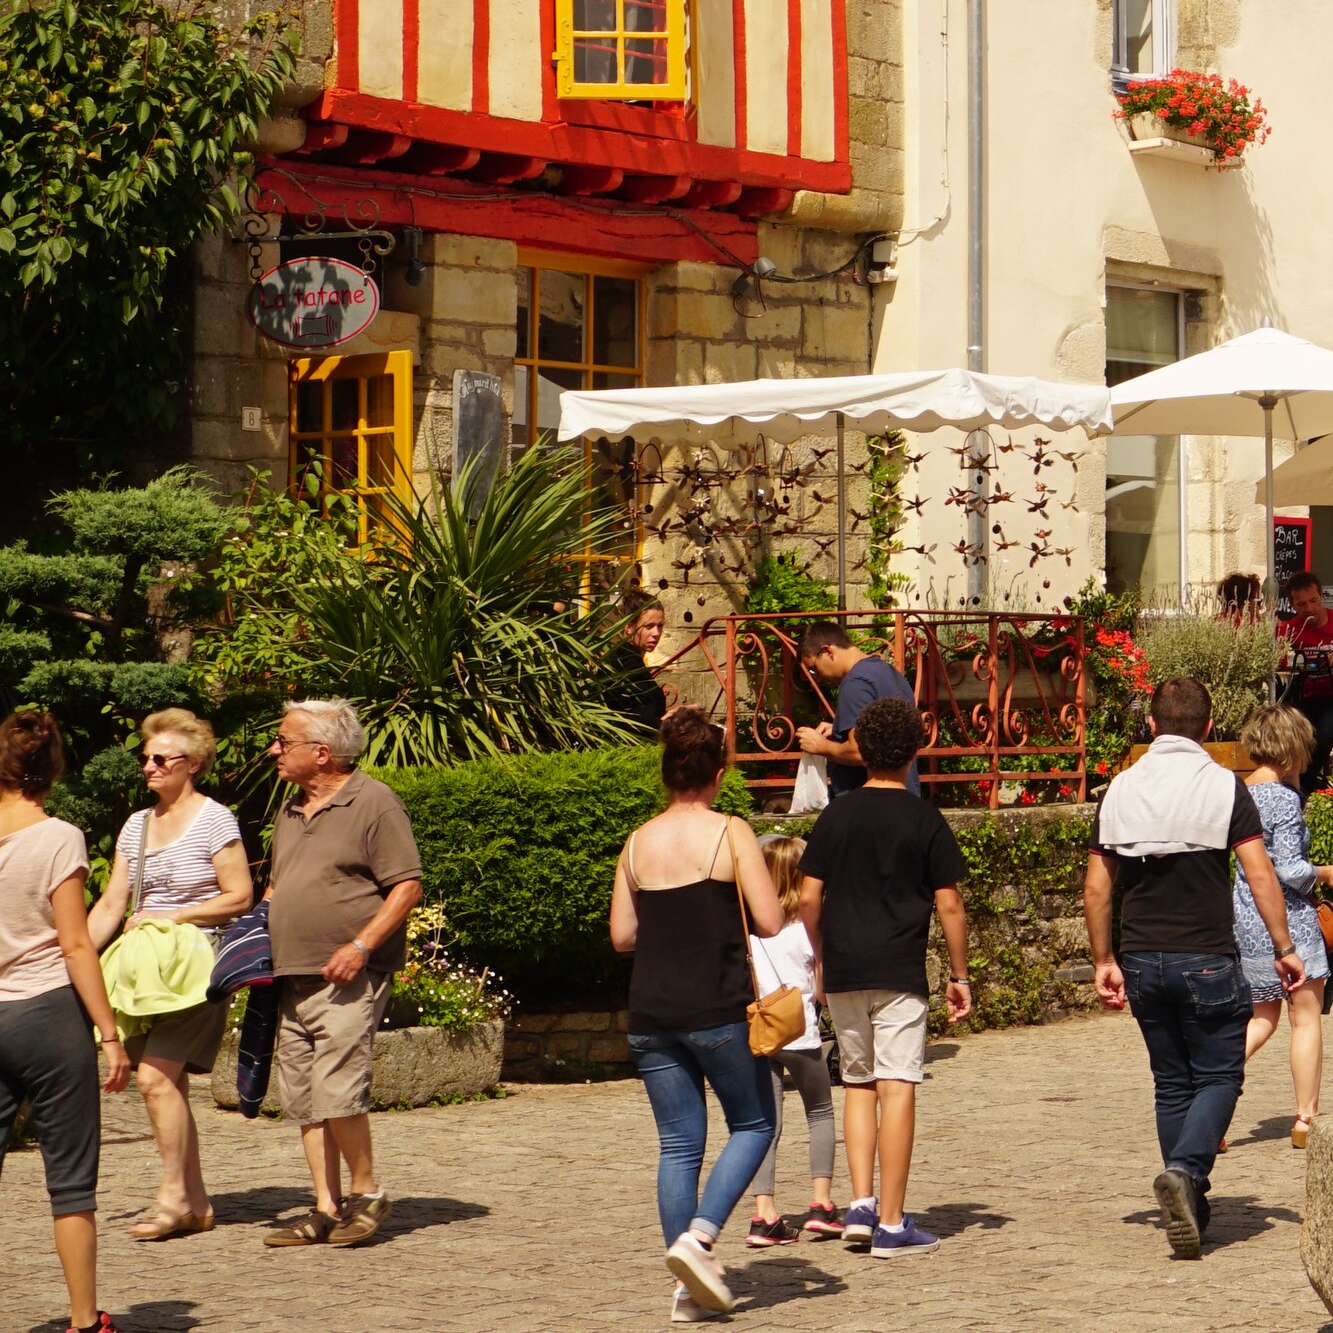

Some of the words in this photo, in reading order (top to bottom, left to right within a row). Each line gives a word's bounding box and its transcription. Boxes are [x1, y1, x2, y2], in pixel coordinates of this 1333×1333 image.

[260, 293, 286, 309] La
[294, 287, 367, 307] tatane
[248, 411, 255, 426] 8
[1275, 526, 1303, 545] BAR
